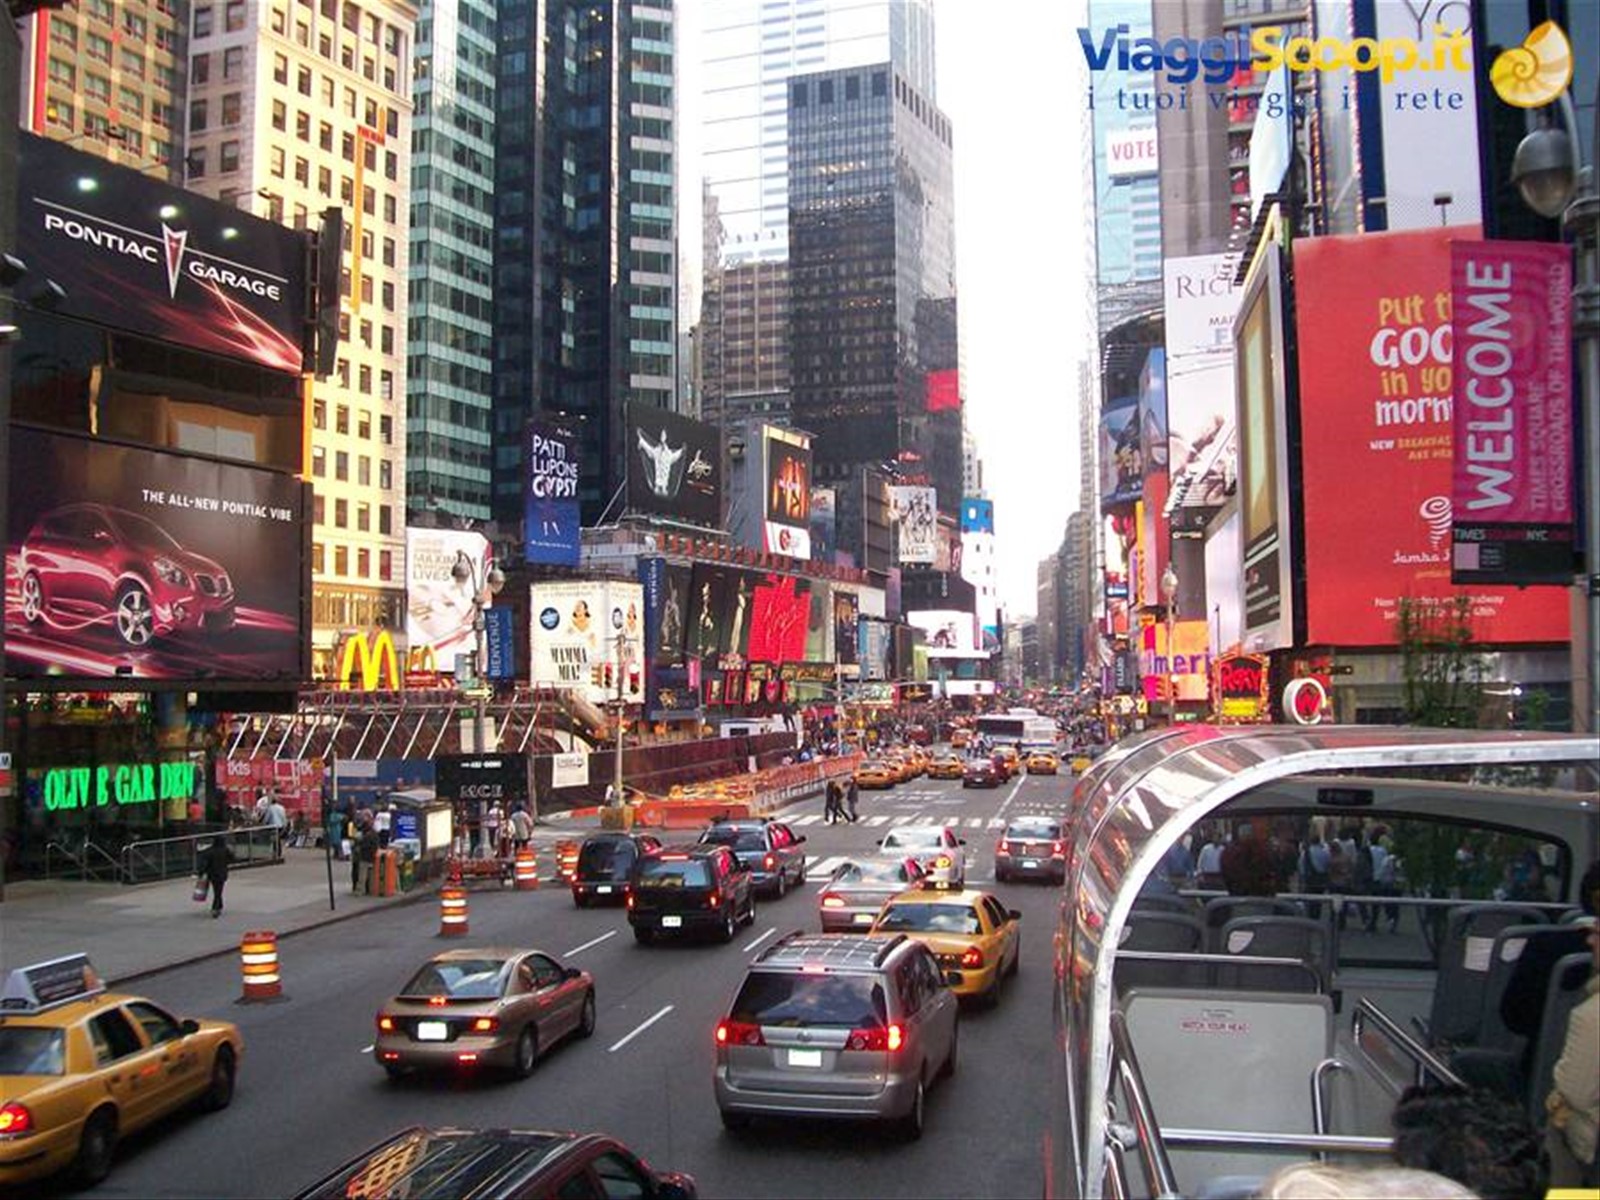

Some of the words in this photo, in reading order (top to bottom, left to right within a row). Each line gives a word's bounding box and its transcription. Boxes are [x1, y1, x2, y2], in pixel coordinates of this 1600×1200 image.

[1112, 140, 1156, 160] VOTE
[44, 213, 159, 263] PONTIAC
[188, 260, 281, 300] GARAGE
[1381, 371, 1408, 396] in
[1467, 260, 1514, 510] WELCOME
[533, 434, 566, 460] PATTI
[1370, 439, 1395, 450] NEW
[533, 455, 578, 478] LUPONE
[532, 475, 578, 498] GYPSY
[142, 489, 164, 504] THE
[168, 494, 219, 510] ALL-NEW
[222, 500, 267, 518] PONTIAC
[270, 507, 292, 521] VIBE
[412, 570, 450, 582] LIVES
[487, 612, 502, 677] BIENVENUE
[550, 648, 588, 663] MAMMA
